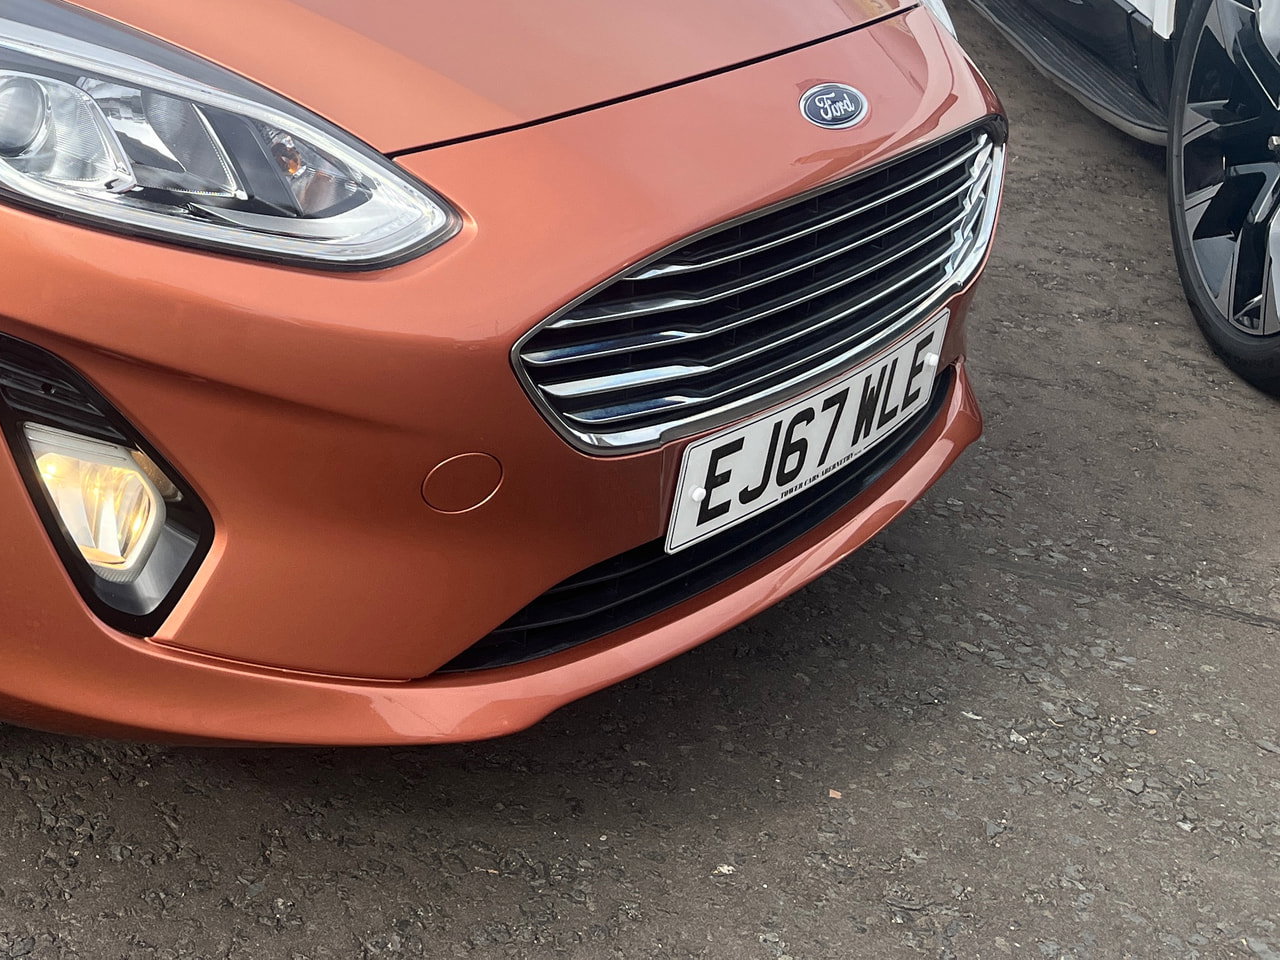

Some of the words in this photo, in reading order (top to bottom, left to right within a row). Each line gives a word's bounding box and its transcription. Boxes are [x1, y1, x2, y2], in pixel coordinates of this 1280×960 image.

[814, 92, 855, 121] Ford
[696, 386, 851, 528] EJ67
[851, 329, 935, 448] WLE
